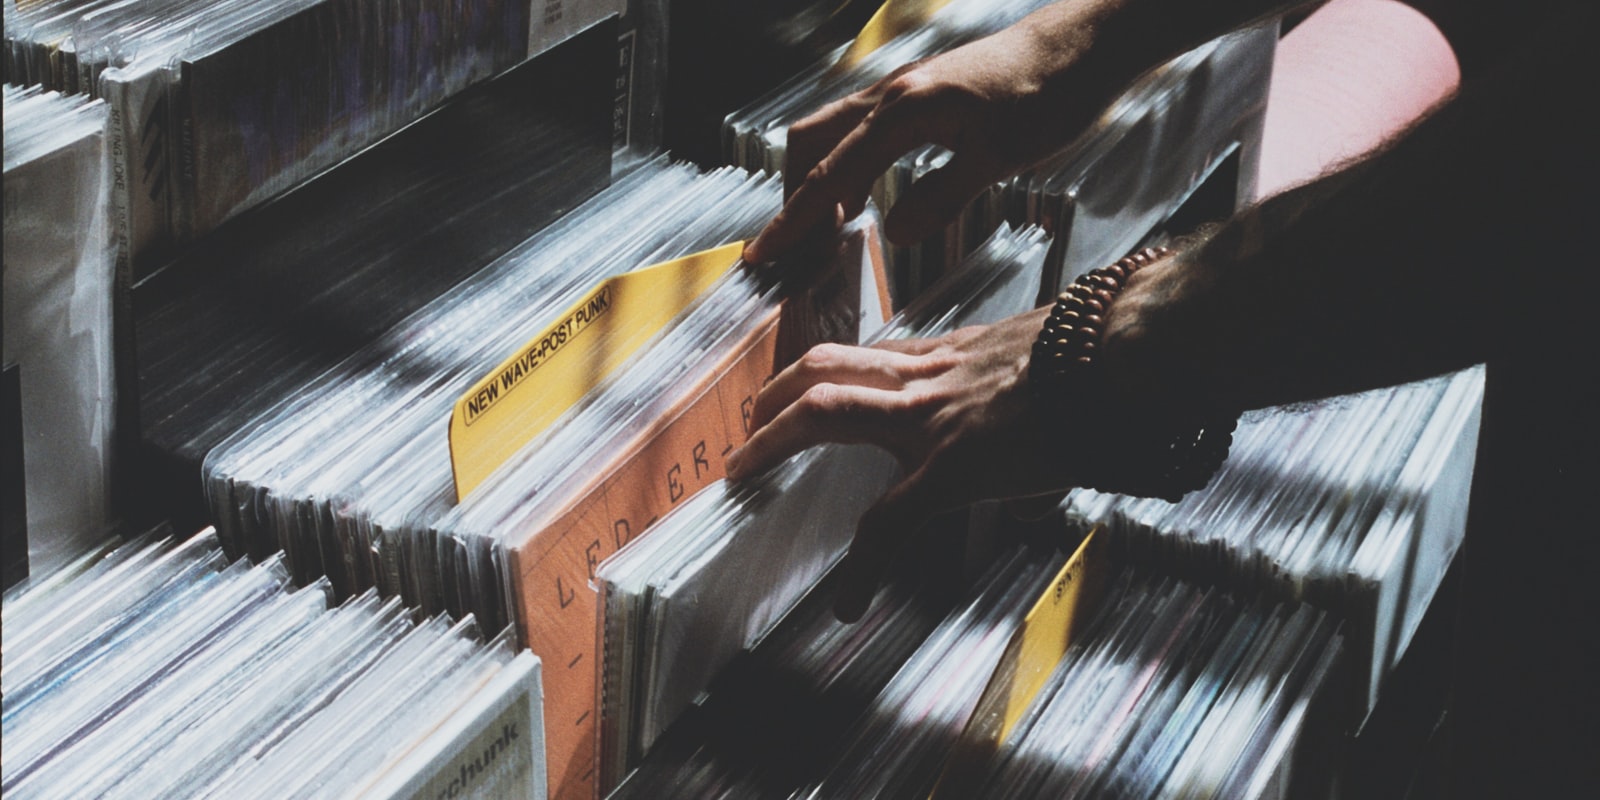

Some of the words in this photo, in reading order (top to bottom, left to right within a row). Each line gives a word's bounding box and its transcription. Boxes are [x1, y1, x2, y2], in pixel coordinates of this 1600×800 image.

[113, 157, 125, 190] JOKE
[468, 379, 498, 418] NEW
[575, 290, 607, 329] PUNK
